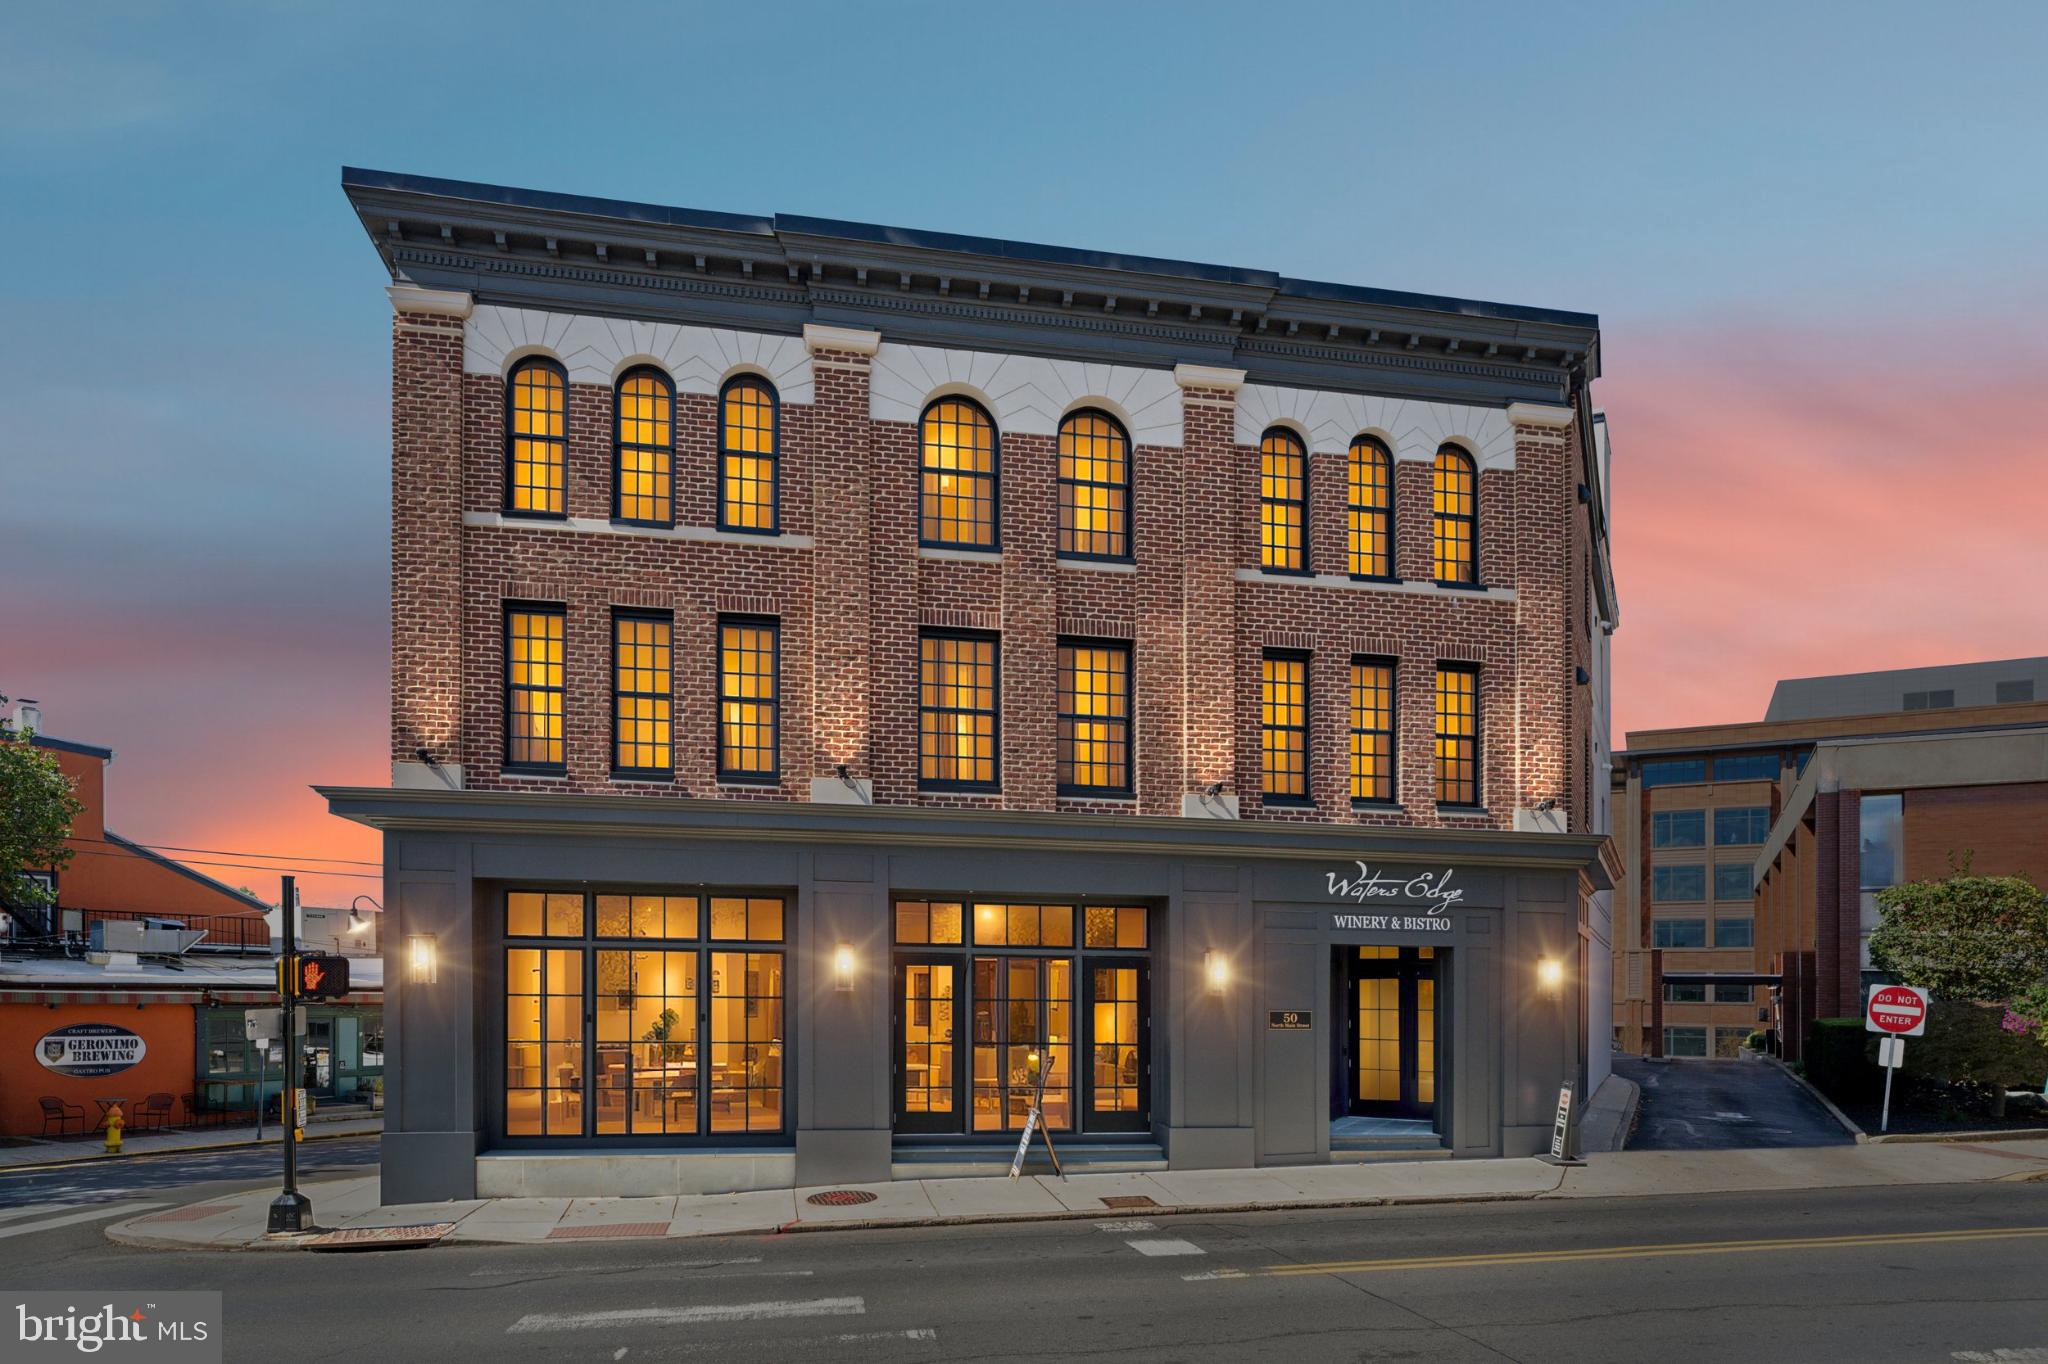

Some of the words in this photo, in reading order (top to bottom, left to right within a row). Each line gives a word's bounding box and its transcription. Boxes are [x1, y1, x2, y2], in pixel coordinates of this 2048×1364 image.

[1325, 860, 1408, 904] Waters
[1404, 868, 1464, 916] Edge
[1334, 915, 1389, 929] WINERY
[1391, 916, 1401, 929] &
[1404, 916, 1451, 931] BISTRO
[1878, 994, 1892, 1003] DO
[1897, 996, 1918, 1005] NOT
[1283, 1013, 1298, 1023] 50
[1880, 1015, 1912, 1025] ENTER
[68, 1038, 139, 1051] GERONIMO
[72, 1050, 135, 1062] BREWING
